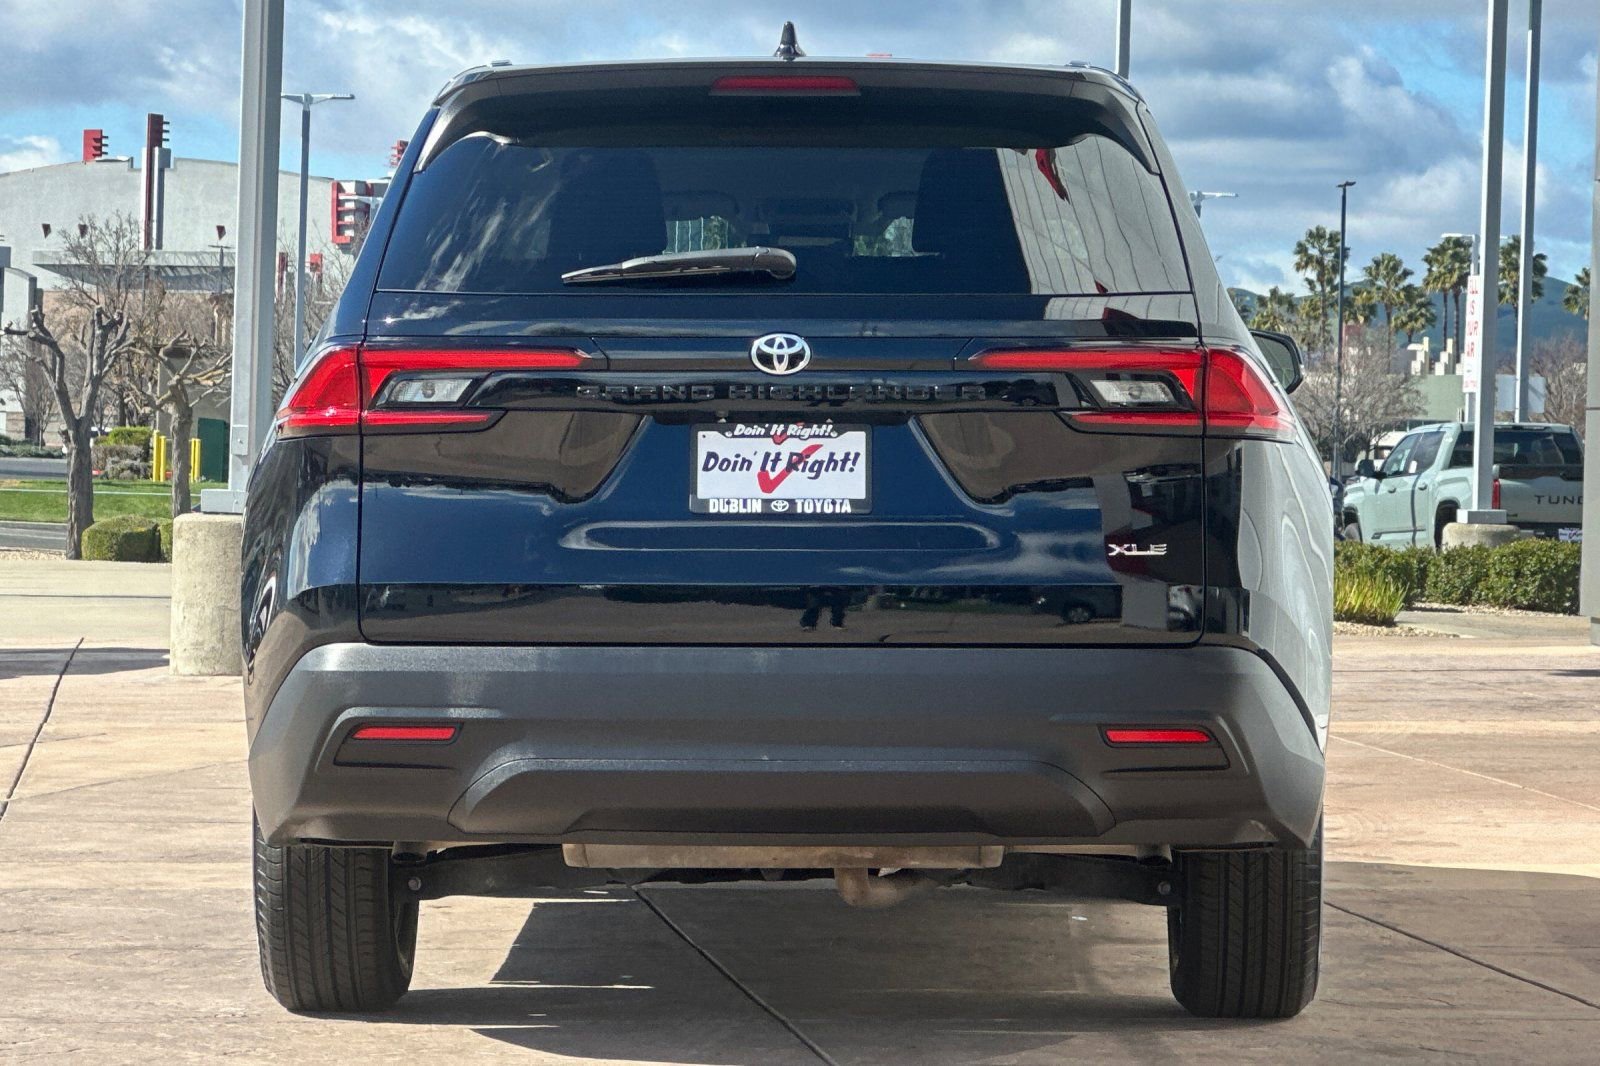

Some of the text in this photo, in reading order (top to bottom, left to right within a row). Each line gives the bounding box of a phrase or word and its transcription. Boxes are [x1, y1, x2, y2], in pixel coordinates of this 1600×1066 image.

[576, 385, 986, 401] GRAND HIGHLANDER
[733, 423, 832, 440] Doin' It Right!
[701, 450, 861, 480] Doin' It Right!
[709, 498, 852, 513] DUBLIN TOYOTA
[1107, 543, 1168, 556] XLE
